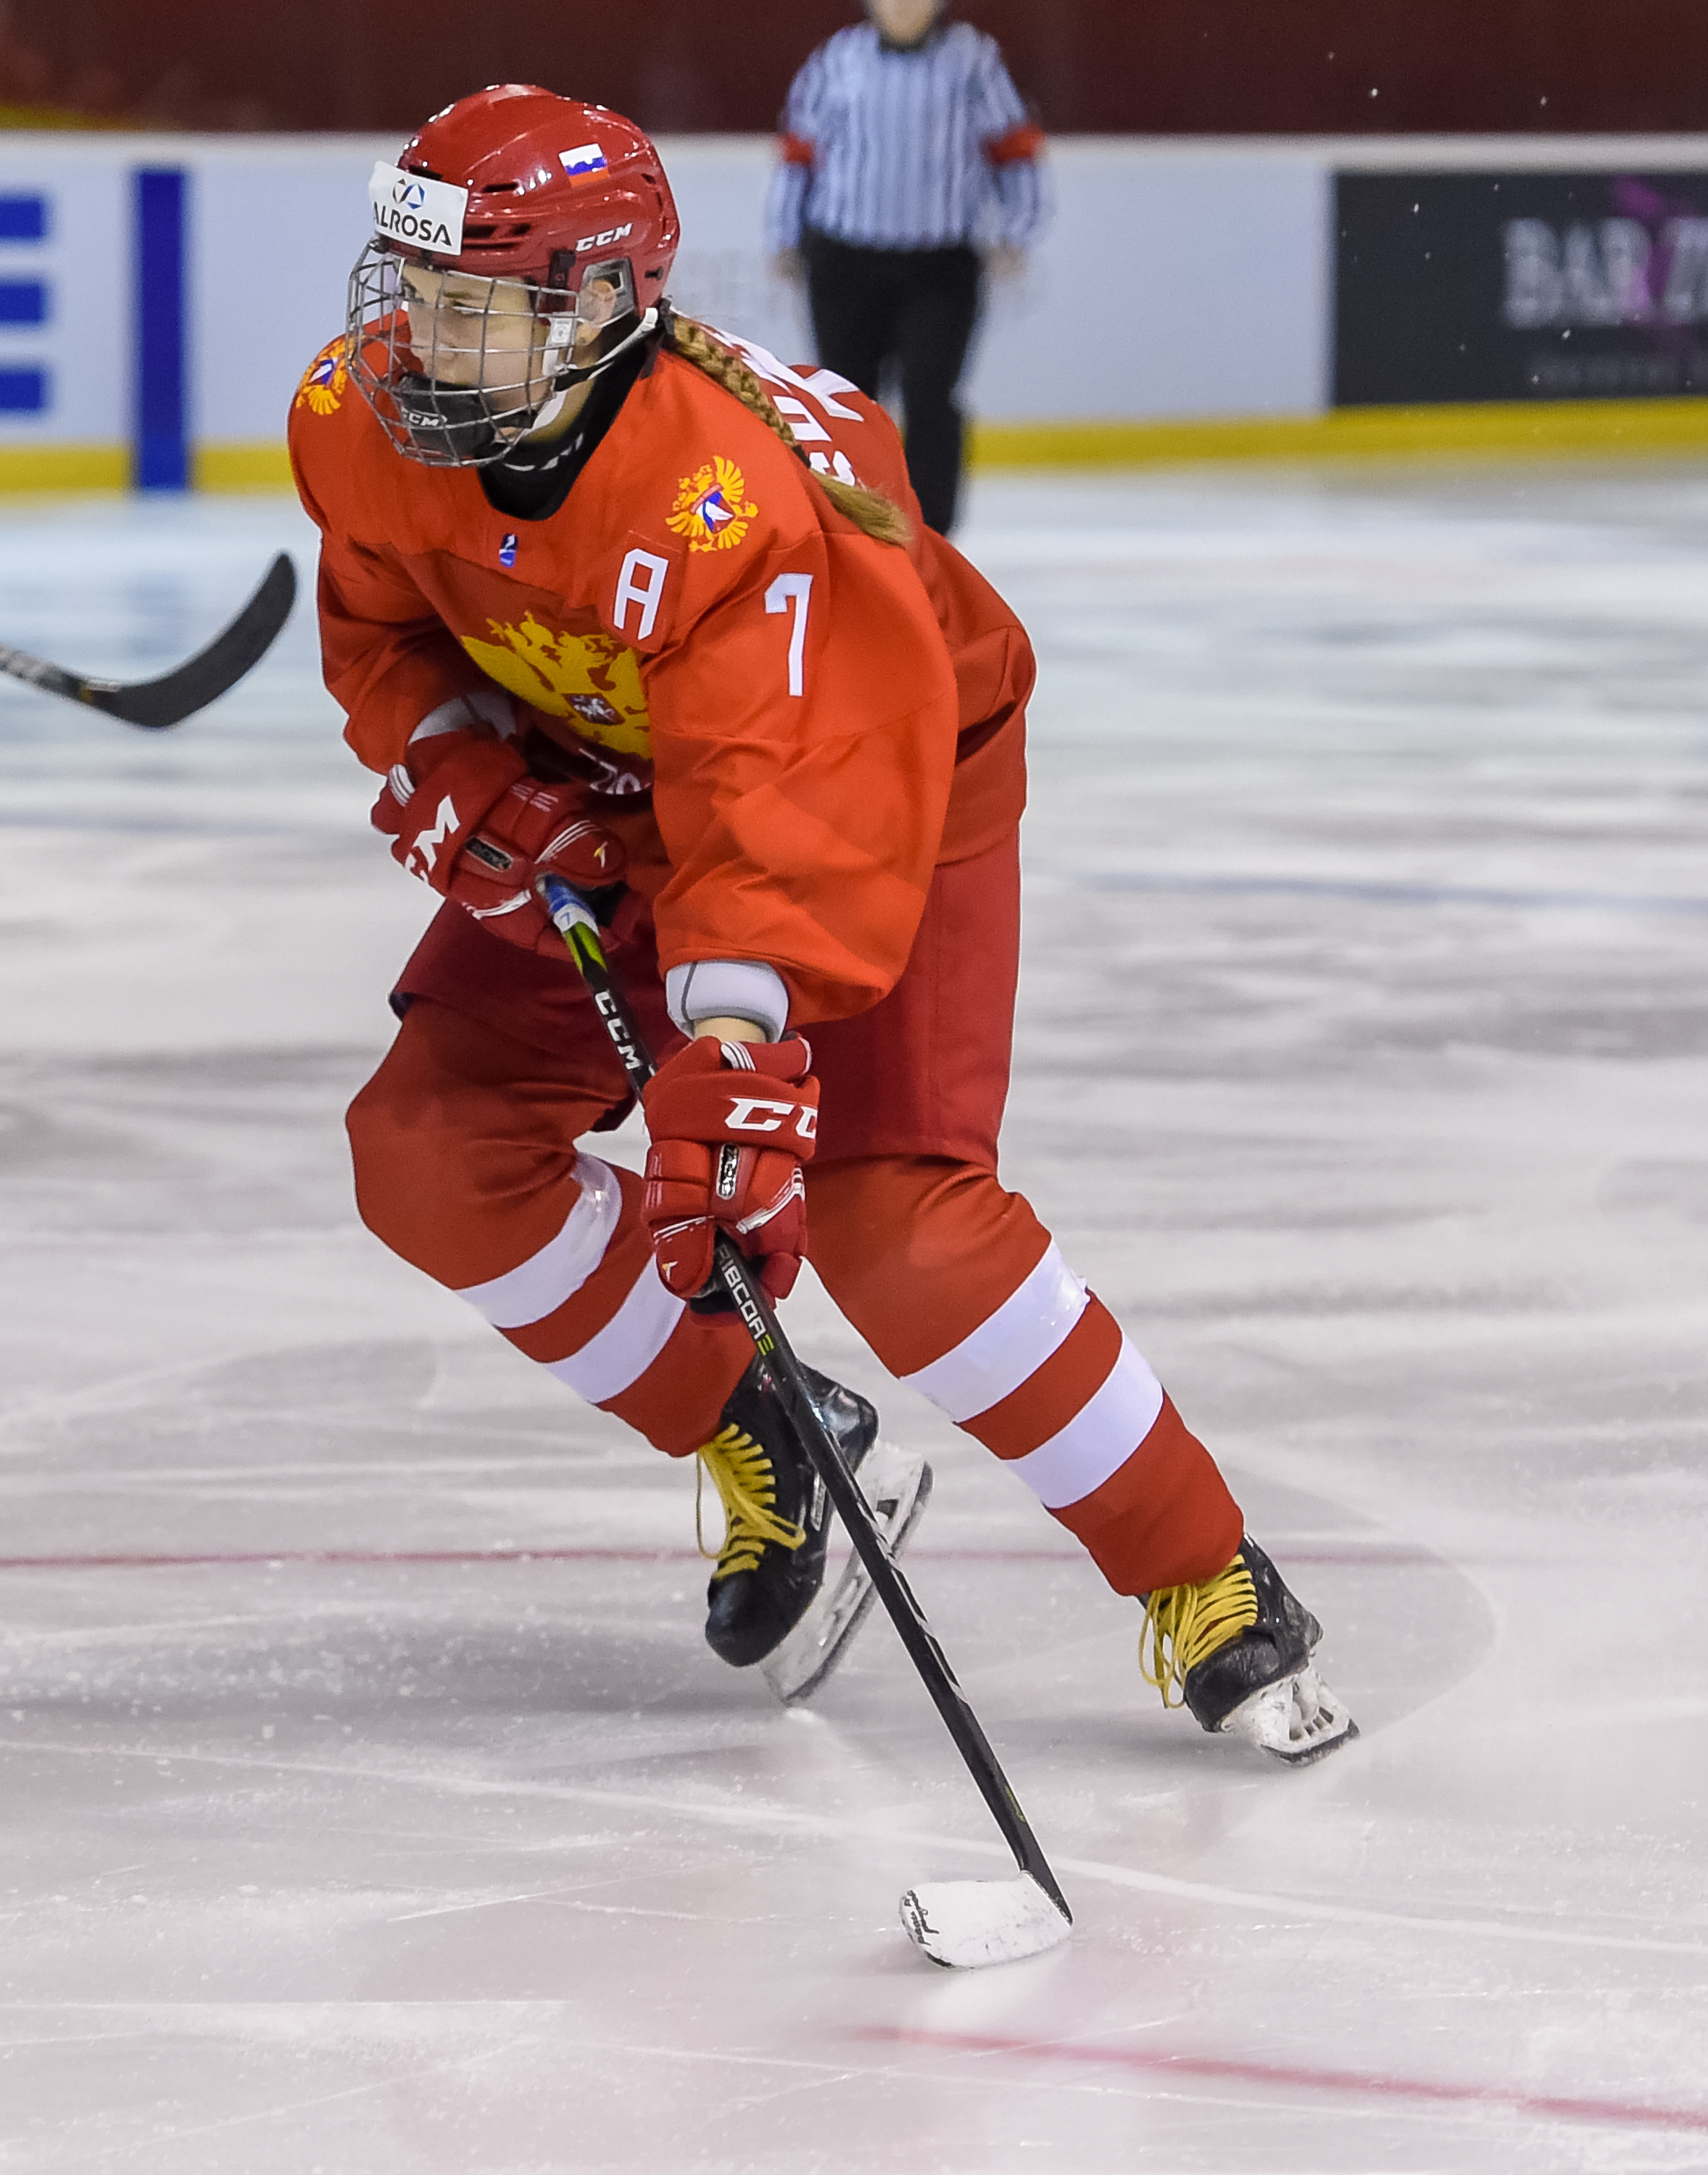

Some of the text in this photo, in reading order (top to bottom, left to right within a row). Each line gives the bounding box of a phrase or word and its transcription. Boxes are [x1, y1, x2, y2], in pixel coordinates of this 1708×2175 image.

[576, 223, 633, 252] CCM
[403, 412, 439, 426] CM
[613, 548, 669, 640] A
[764, 573, 814, 697] 7
[594, 988, 642, 1070] CCM
